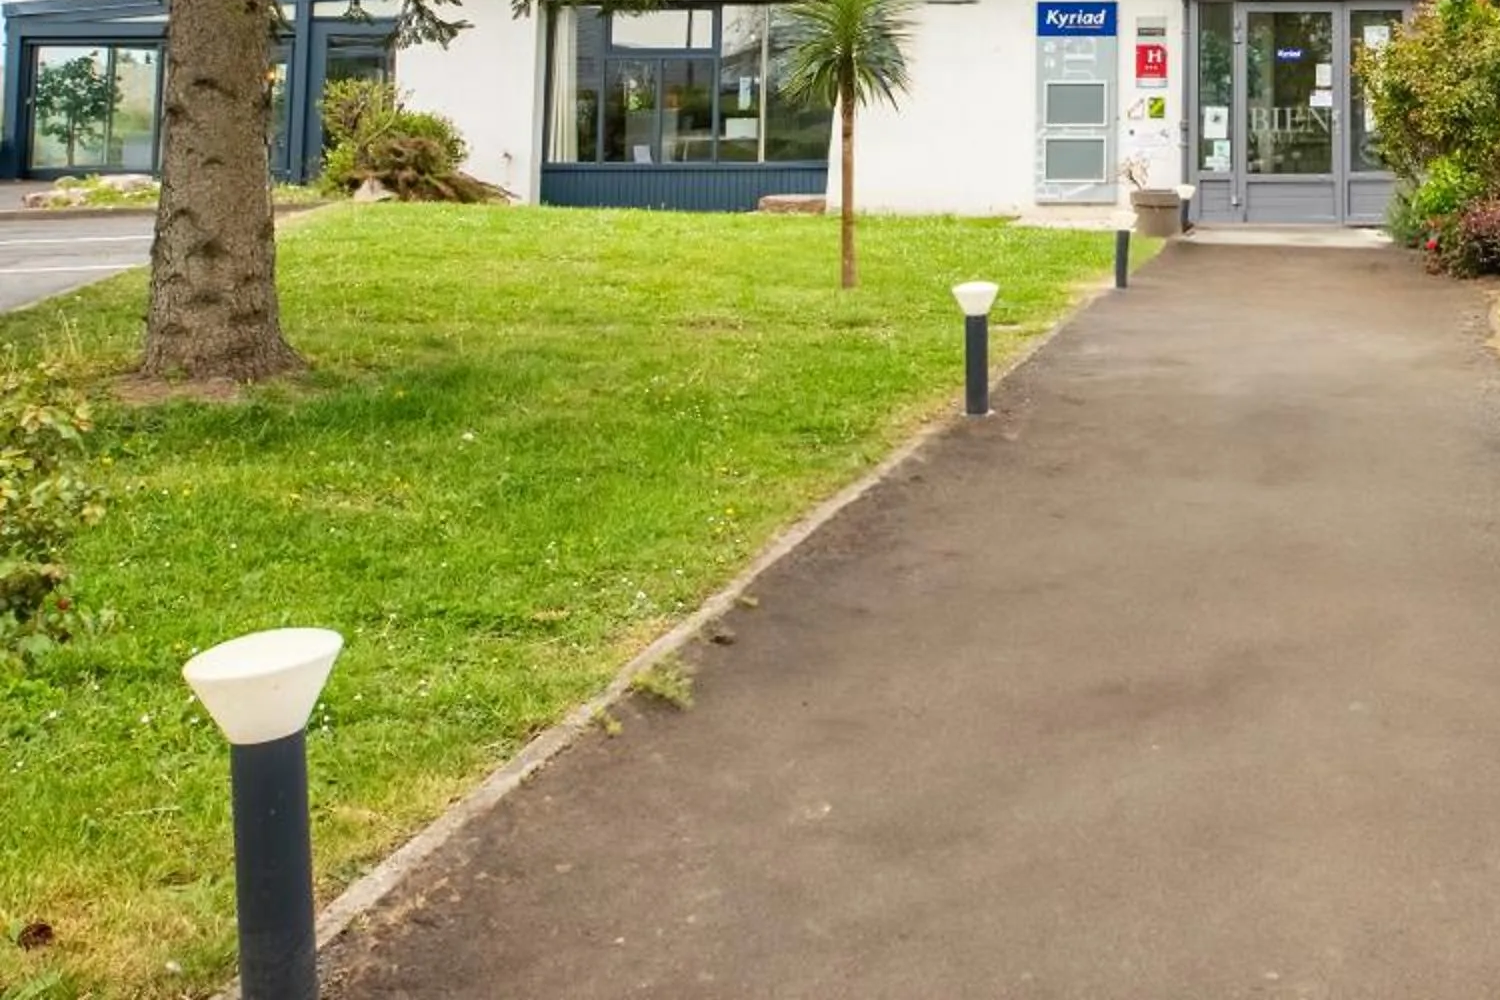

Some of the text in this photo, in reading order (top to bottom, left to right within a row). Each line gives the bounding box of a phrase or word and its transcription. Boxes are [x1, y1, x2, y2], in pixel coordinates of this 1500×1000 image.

[1045, 8, 1107, 29] Kyriad
[1147, 49, 1162, 64] H
[1249, 106, 1331, 133] BIEN
